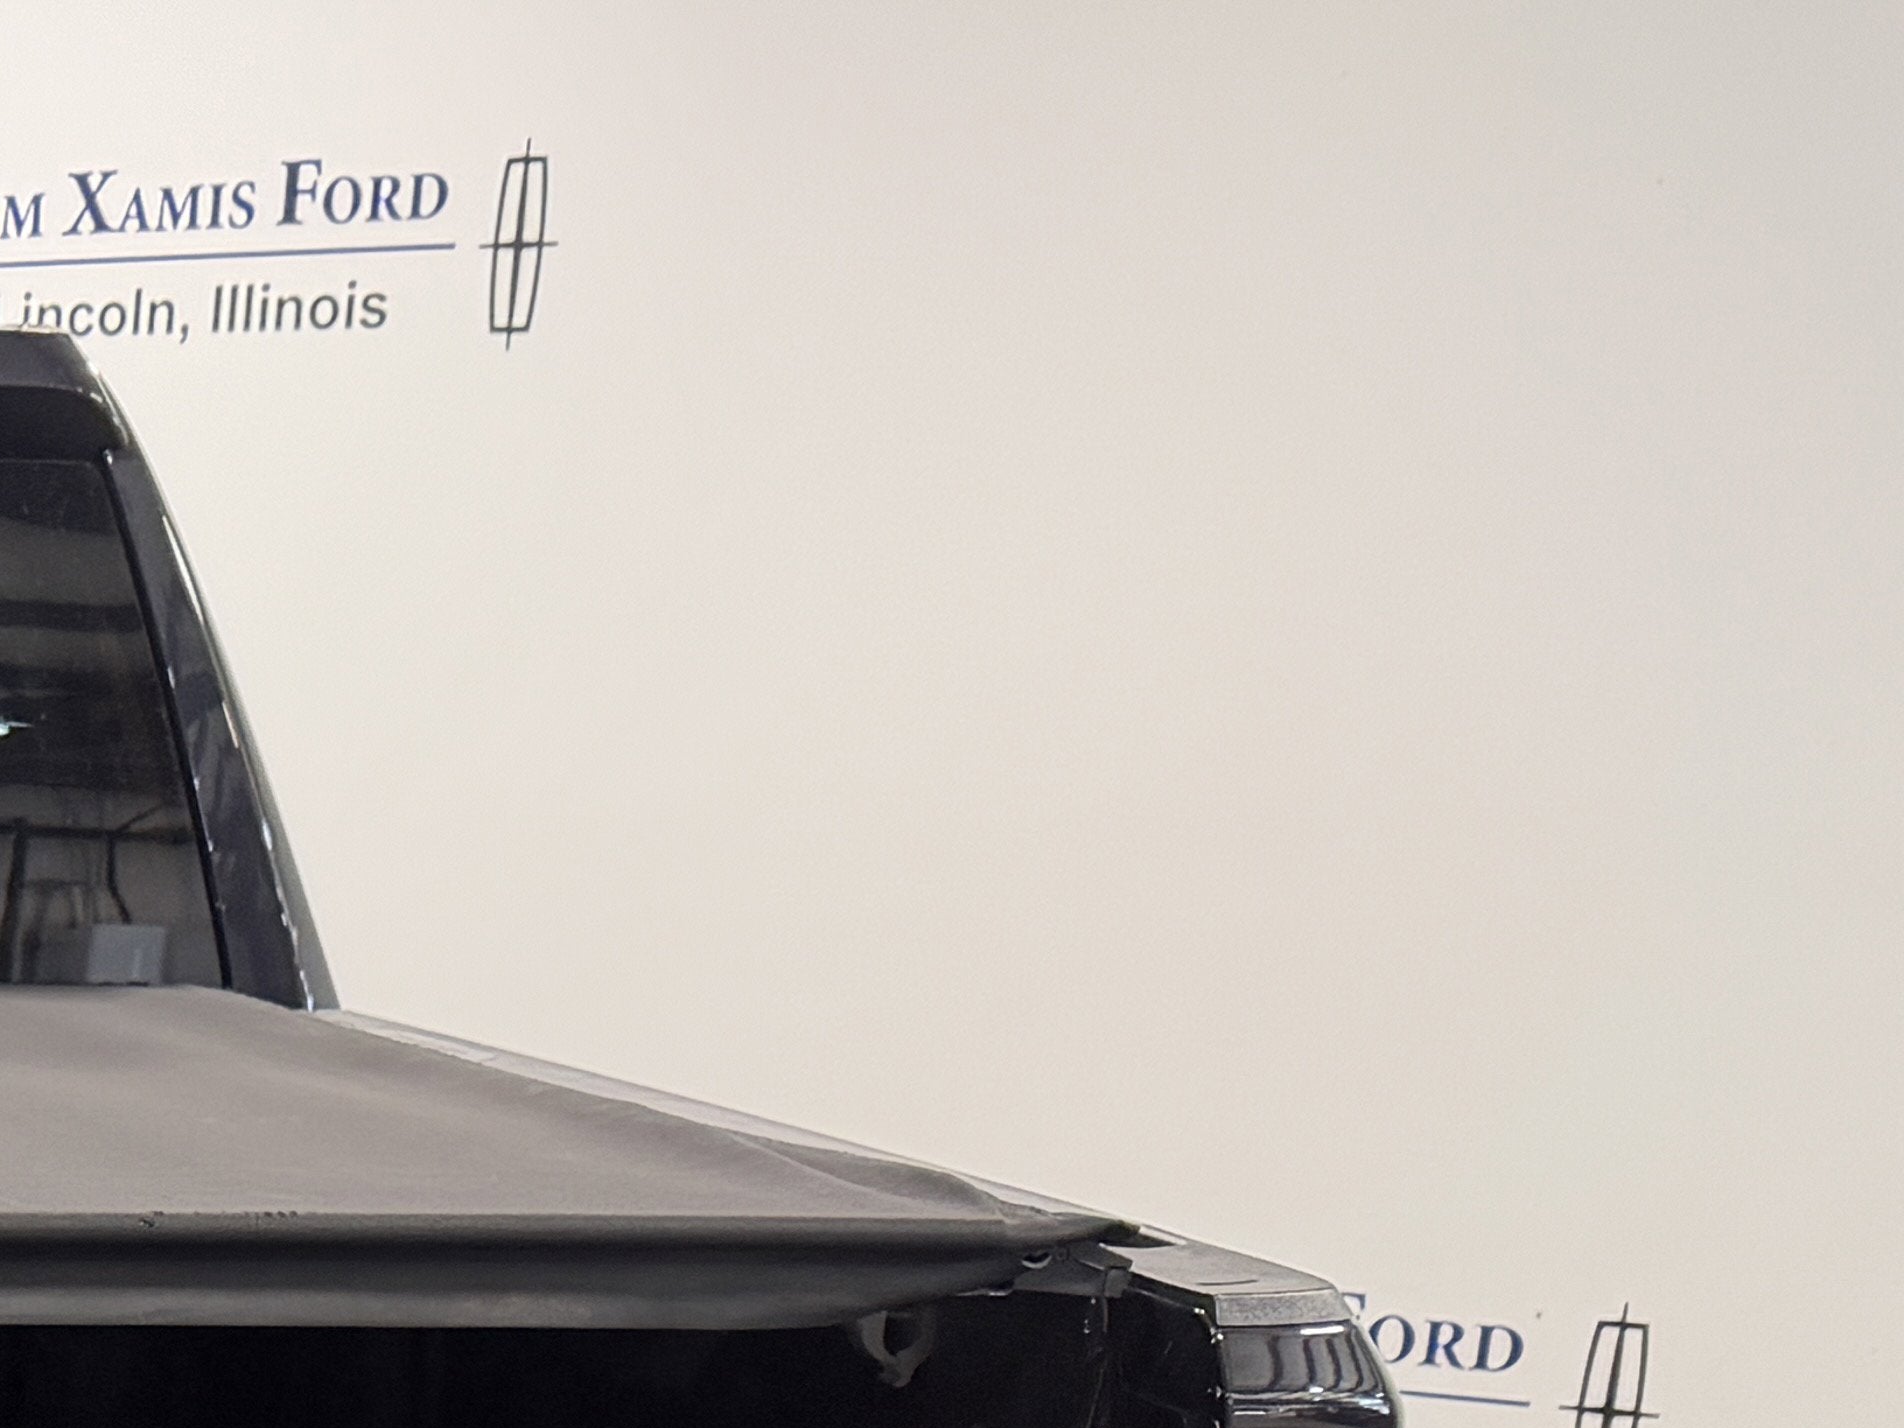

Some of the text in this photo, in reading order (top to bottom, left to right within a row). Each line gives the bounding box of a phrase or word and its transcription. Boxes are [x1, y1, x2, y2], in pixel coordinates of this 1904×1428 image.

[61, 169, 257, 237] XAMIS
[277, 158, 451, 227] FORD
[211, 279, 389, 334] Illinois
[1342, 1292, 1525, 1373] ORD
